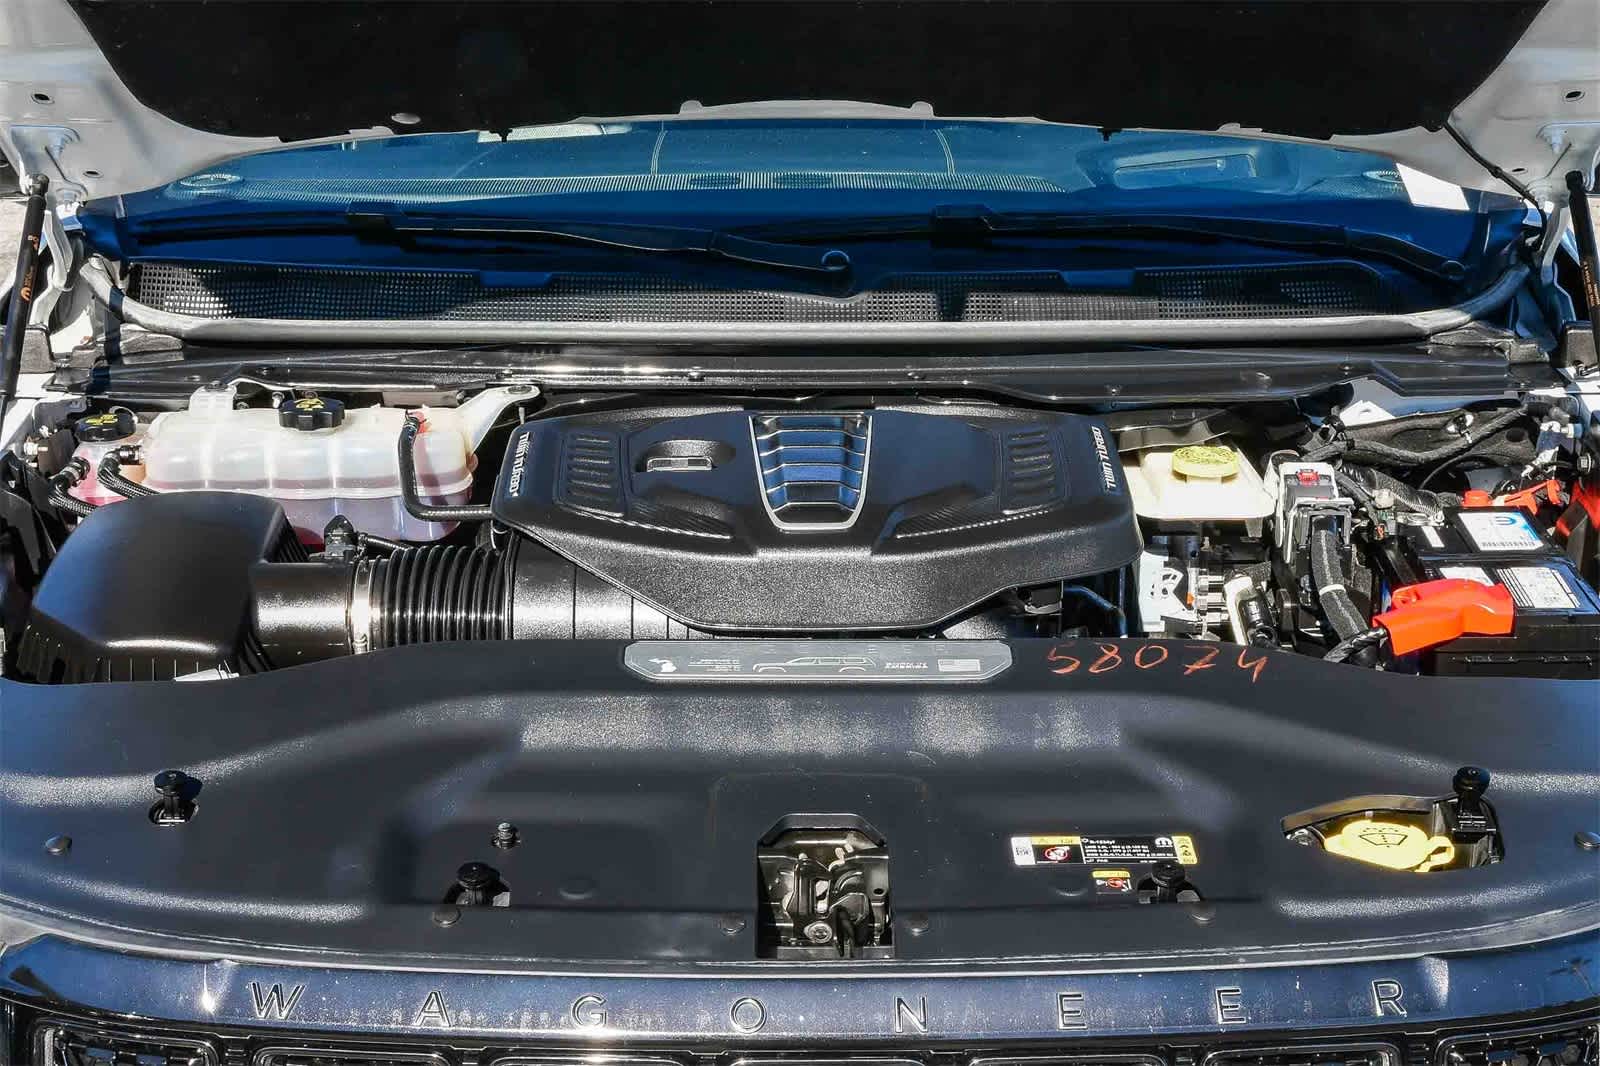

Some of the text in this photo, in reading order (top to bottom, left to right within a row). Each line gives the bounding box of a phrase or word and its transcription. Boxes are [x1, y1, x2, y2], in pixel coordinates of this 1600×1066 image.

[1091, 425, 1117, 489] TWIN TURBO
[1047, 641, 1269, 683] 58074
[250, 979, 1408, 1034] WAGONEER
